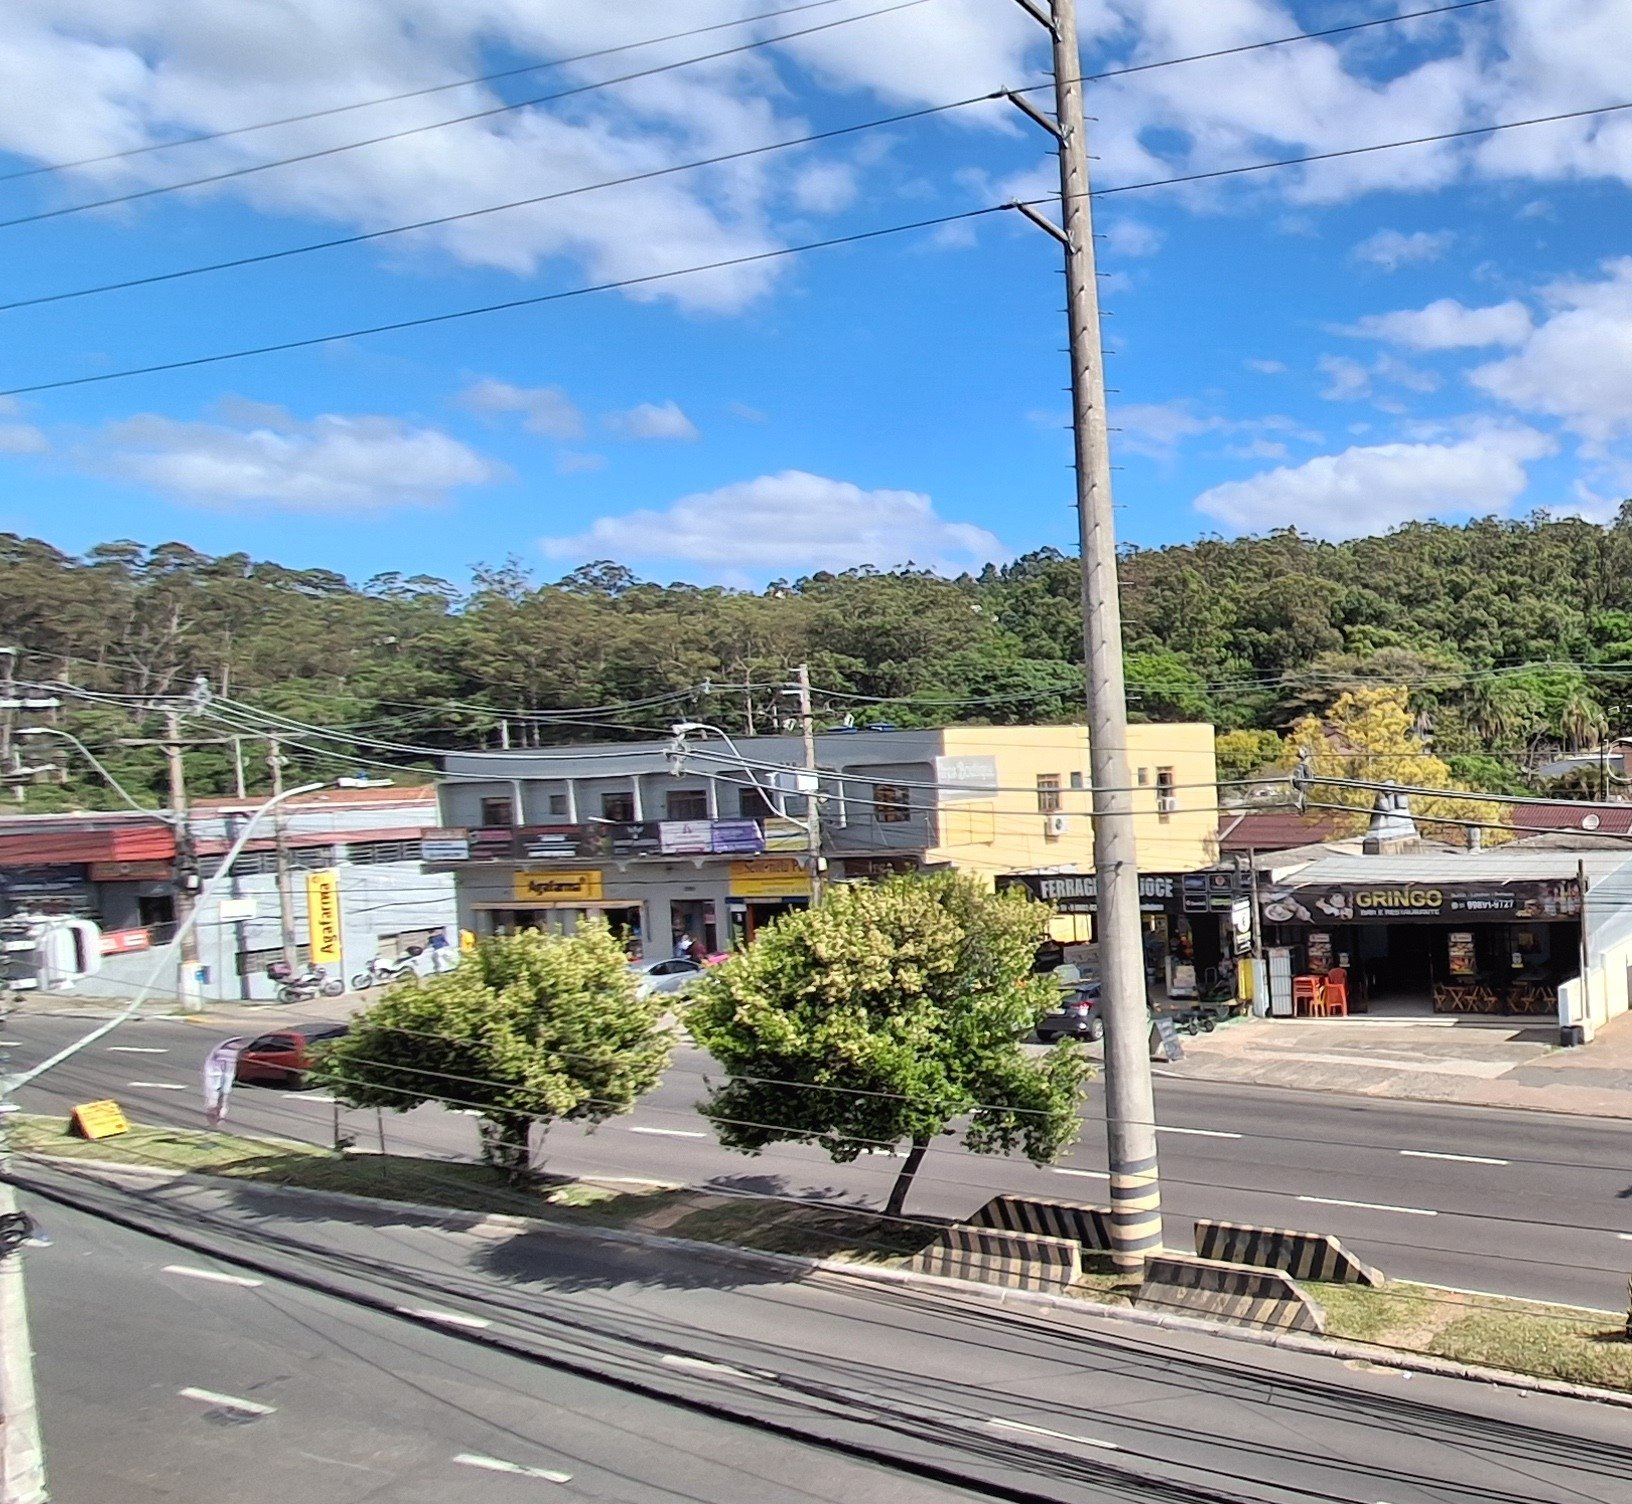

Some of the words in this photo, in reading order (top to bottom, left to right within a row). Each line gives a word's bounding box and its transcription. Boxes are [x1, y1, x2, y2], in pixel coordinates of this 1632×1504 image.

[528, 880, 581, 895] Agafarma
[1357, 890, 1442, 907] GRINGO
[319, 883, 337, 953] Agafarma
